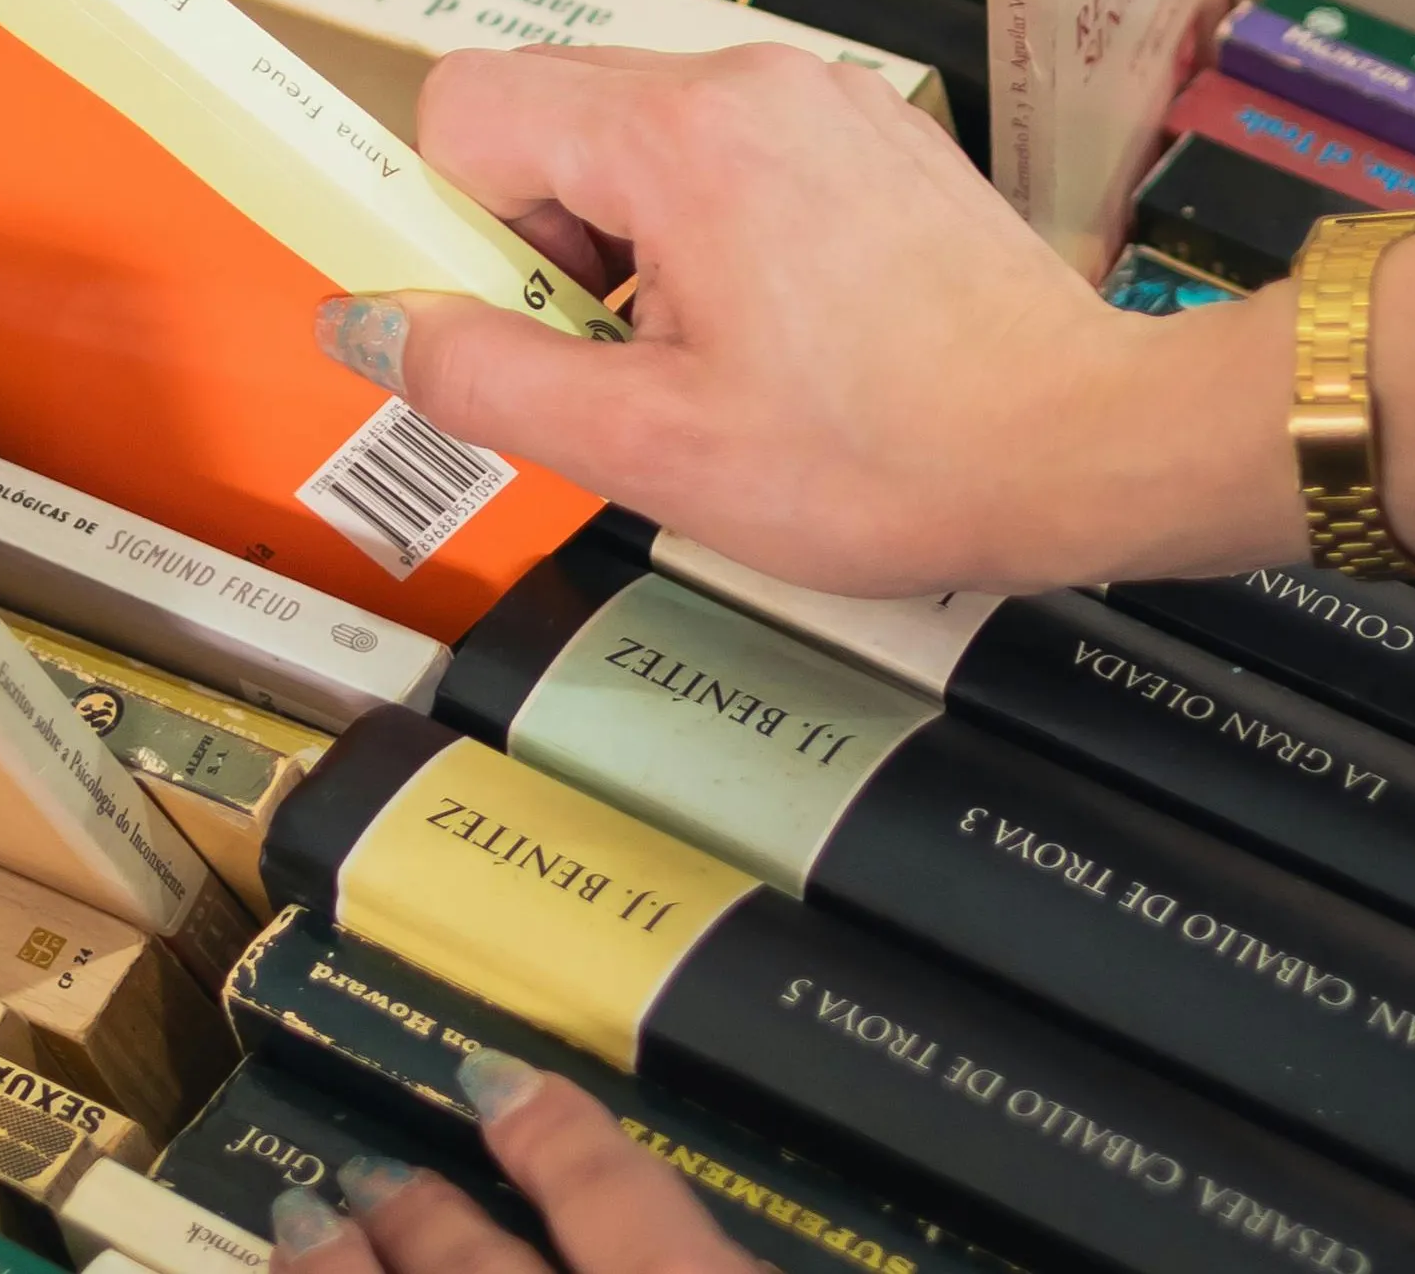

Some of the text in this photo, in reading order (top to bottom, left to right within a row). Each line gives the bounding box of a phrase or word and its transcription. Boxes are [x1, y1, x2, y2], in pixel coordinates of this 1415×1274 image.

[250, 55, 401, 182] Anna Freud
[522, 270, 557, 311] 67
[72, 515, 100, 537] DE
[105, 526, 218, 591] SIGMUND
[218, 572, 303, 625] FREUD
[600, 631, 857, 771] J.J. BENÍTEZ
[1068, 638, 1387, 802] LA GRAN OLEADA
[186, 735, 214, 777] ALEPH
[64, 750, 122, 823] Psicologia
[113, 809, 139, 835] do
[128, 825, 192, 903] Inconsciente
[421, 792, 680, 939] J.J. BENÍTEZ
[987, 816, 1116, 897] TROYA
[1117, 877, 1178, 926] DE
[308, 959, 439, 1039] Howard
[1178, 907, 1356, 1011] CABALLO
[811, 988, 941, 1070] TROYA
[943, 1052, 1007, 1103] DE
[222, 1117, 330, 1193] Grof
[1001, 1081, 1189, 1194] CABALLO
